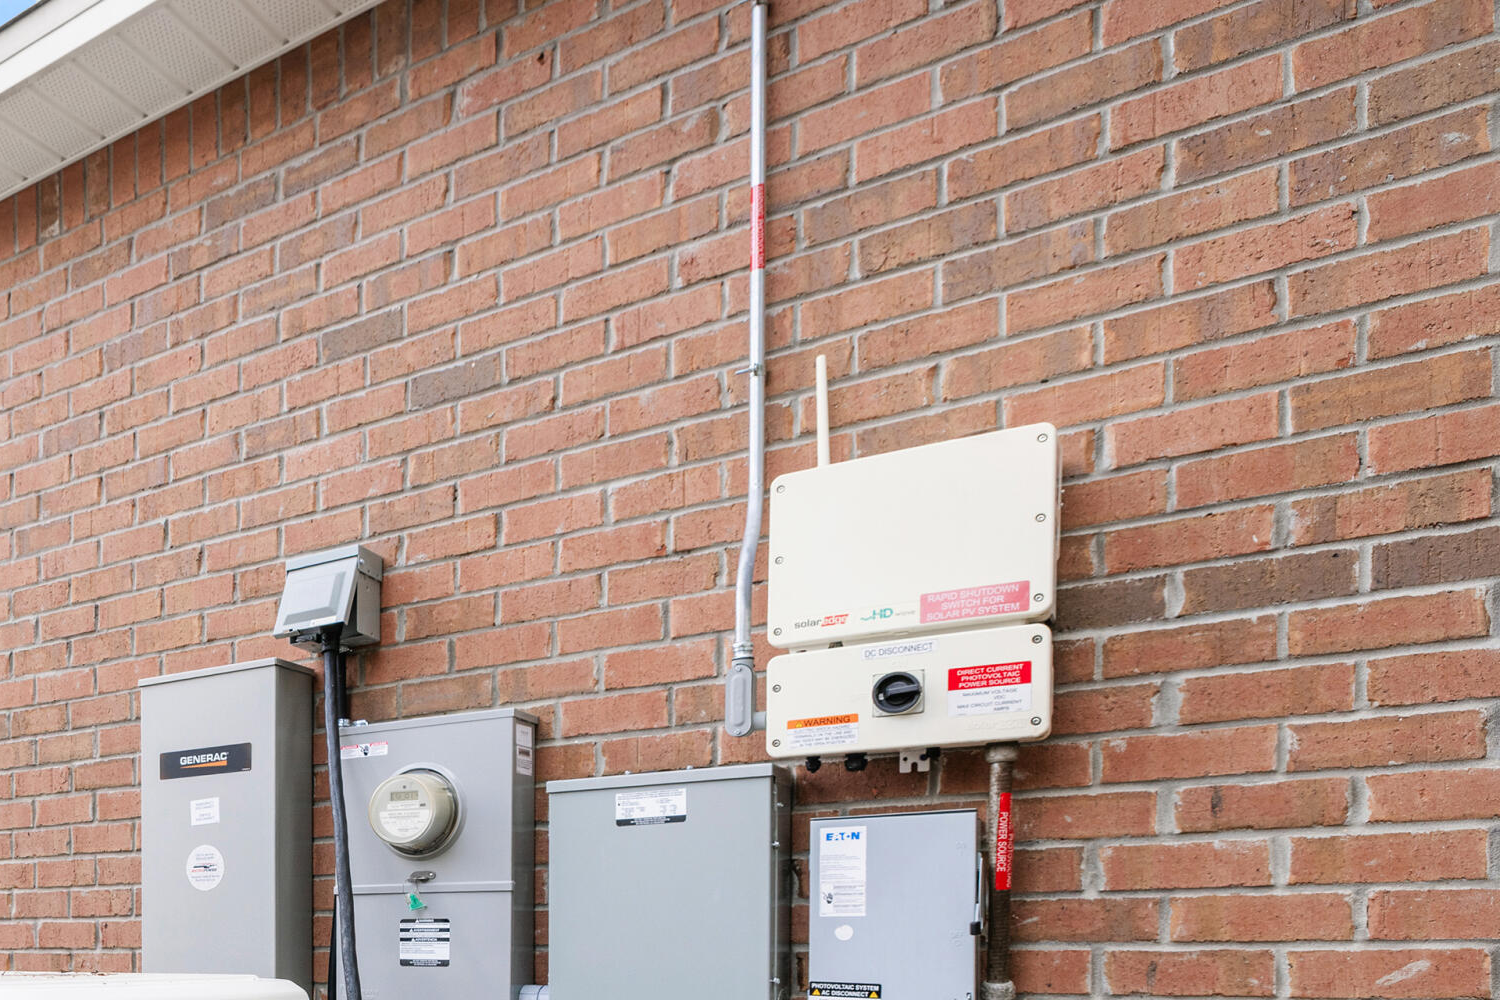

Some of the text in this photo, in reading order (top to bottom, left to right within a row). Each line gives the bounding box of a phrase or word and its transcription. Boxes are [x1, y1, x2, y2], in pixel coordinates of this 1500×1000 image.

[927, 584, 1019, 604] RAPID SHUTDOWN
[940, 595, 1004, 611] SWITCH FOR
[926, 611, 960, 621] SOLAR
[962, 608, 975, 617] PV
[978, 603, 1020, 616] SYSTEM
[865, 642, 933, 658] DC DISCONNECT
[957, 663, 1024, 676] DIRECT CURRENT
[961, 671, 1020, 681] PHOTOVOLTAIC
[988, 677, 1020, 685] SOURCE
[804, 716, 850, 726] WARNING
[180, 752, 228, 765] GENERAC
[997, 811, 1008, 872] POWER SOURCE
